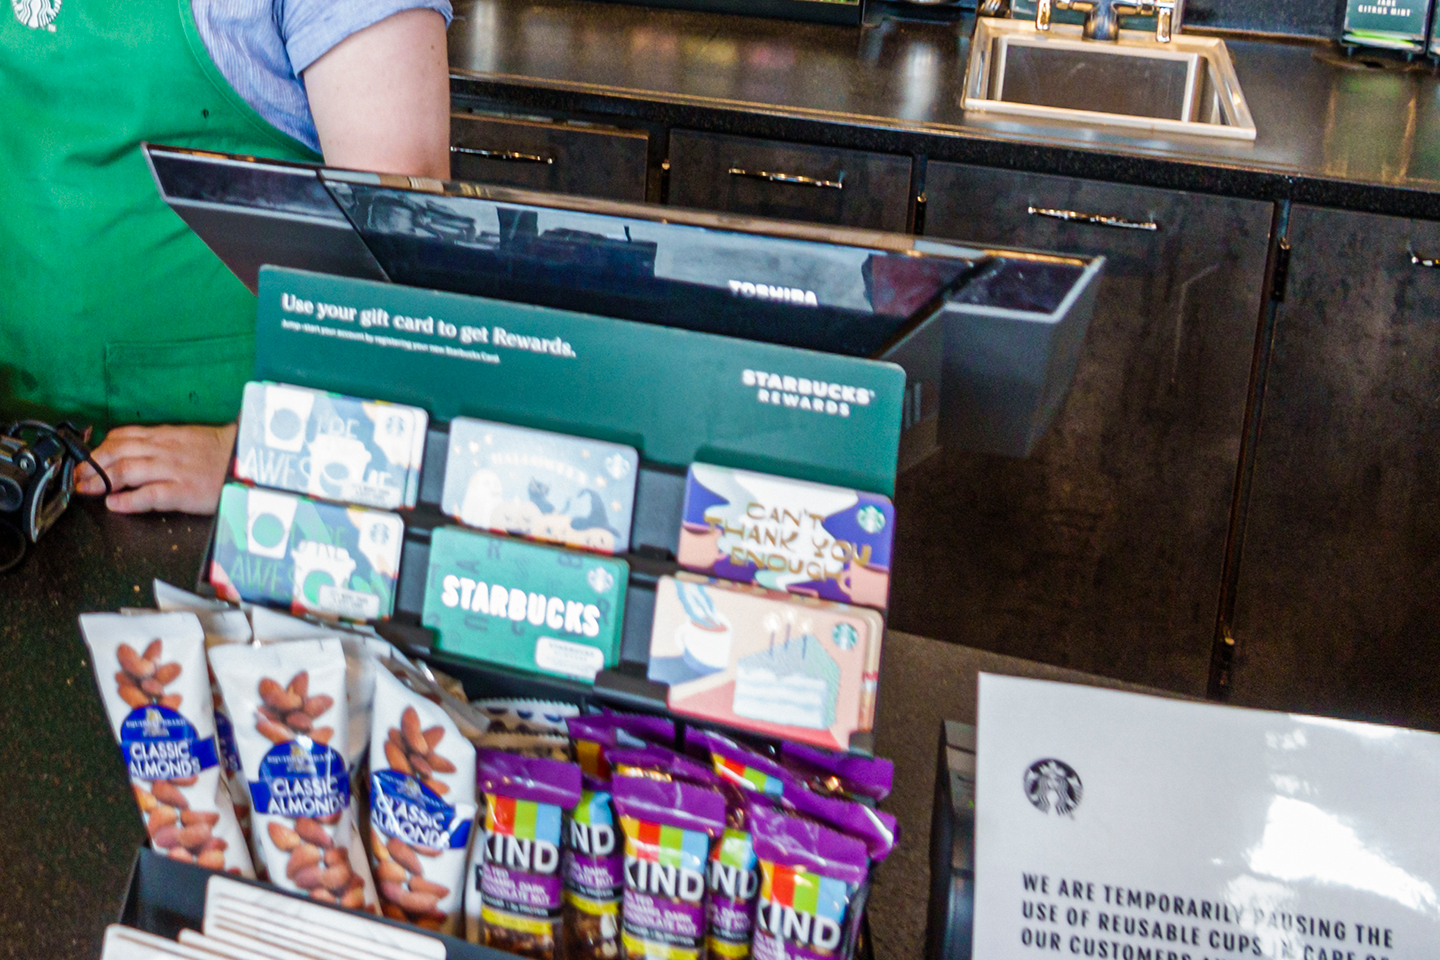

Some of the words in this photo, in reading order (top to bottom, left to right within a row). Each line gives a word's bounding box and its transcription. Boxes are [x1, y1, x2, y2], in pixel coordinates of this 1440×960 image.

[1358, 4, 1388, 15] CITRUS
[281, 292, 314, 314] Use
[316, 302, 357, 321] your
[360, 307, 390, 327] gift
[392, 314, 435, 335] card
[436, 319, 457, 338] to
[459, 324, 489, 344] get
[491, 326, 577, 358] Rewards.
[742, 368, 871, 406] STARBUCKS
[757, 389, 851, 418] REWARDS
[746, 501, 826, 530] CAN'T
[703, 514, 799, 551] THANK
[812, 537, 873, 567] YOU
[730, 546, 842, 581] ENOUGH
[441, 574, 601, 638] STARBUCKS
[130, 741, 190, 761] CLASSIC
[128, 758, 200, 779] ALMONDS
[271, 776, 339, 797] CLASSIC
[268, 791, 348, 816] ALMONDS
[1022, 871, 1050, 894] WE
[1059, 878, 1096, 902] ARE
[1104, 885, 1243, 925] TEMPORARILY
[1254, 907, 1346, 941] PAUSING
[1356, 924, 1393, 950] THE
[1022, 900, 1057, 923] USE
[1067, 907, 1090, 928] OF
[1099, 912, 1201, 947] REUSABLE
[1209, 928, 1262, 957] CUPS
